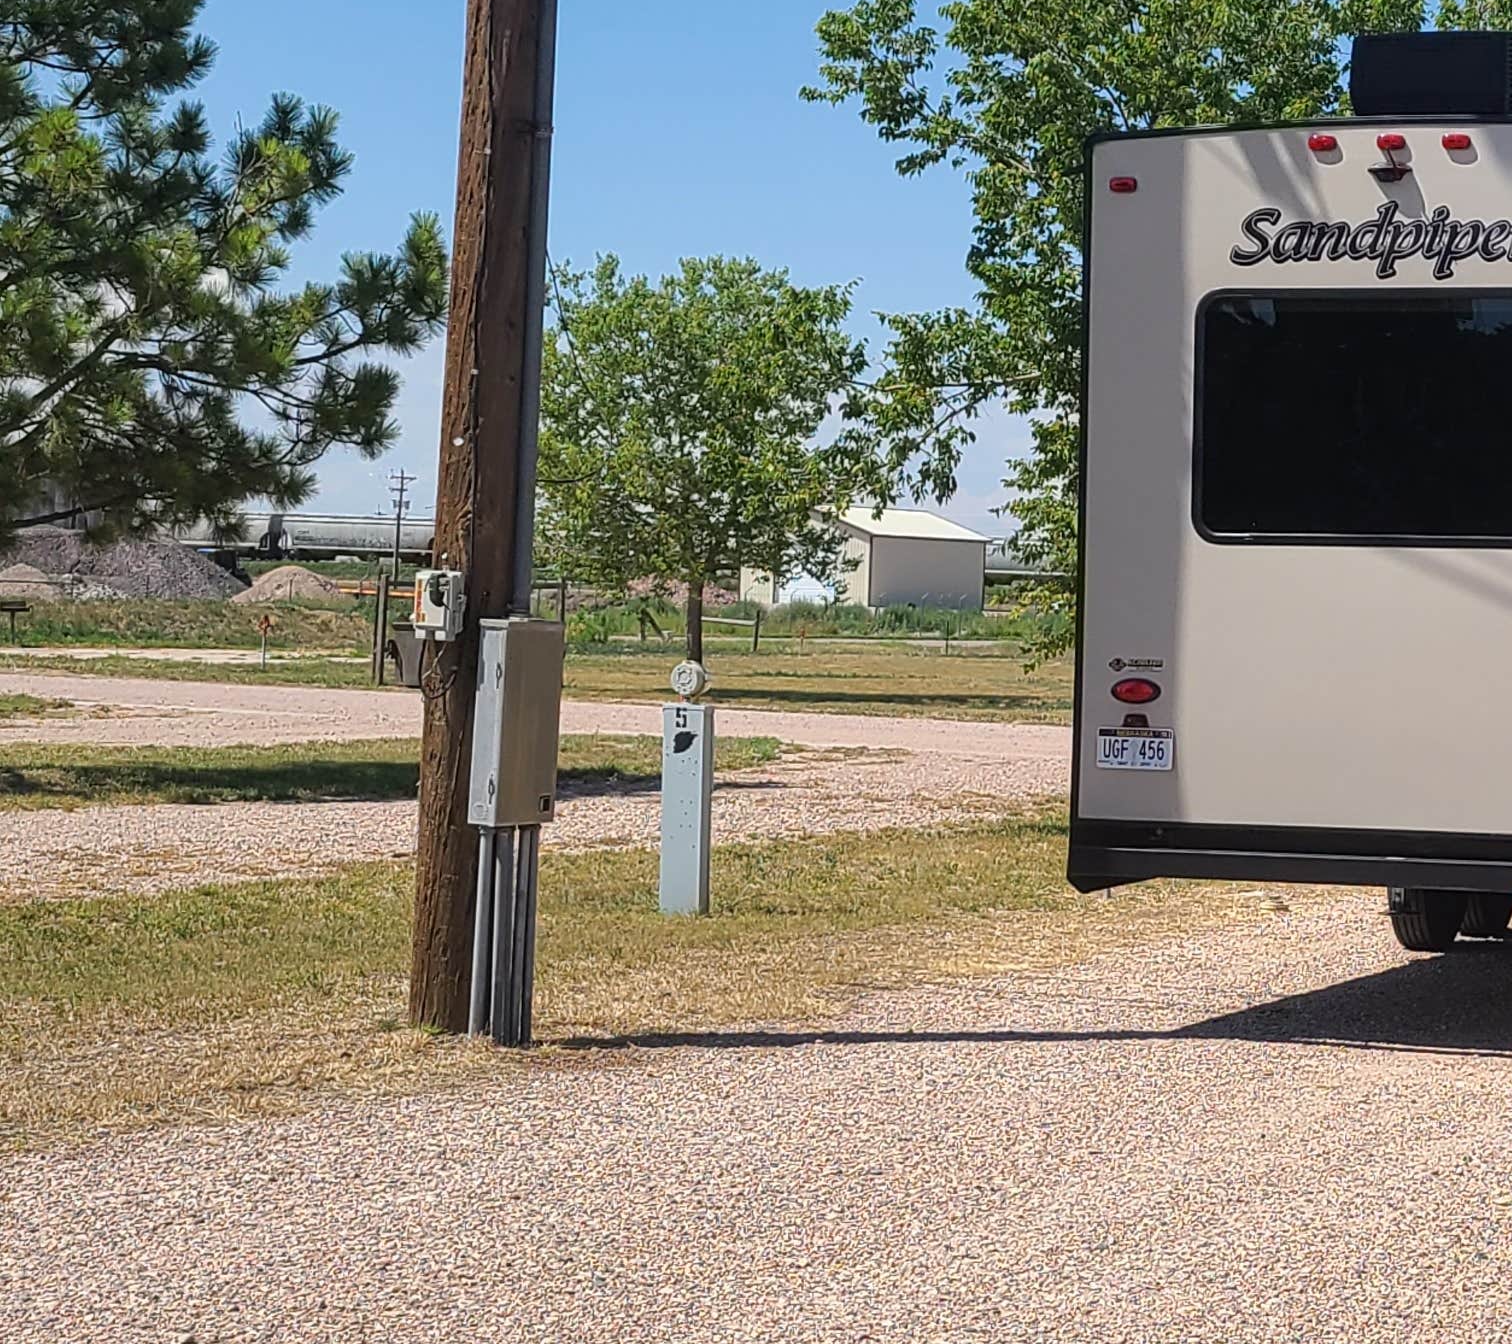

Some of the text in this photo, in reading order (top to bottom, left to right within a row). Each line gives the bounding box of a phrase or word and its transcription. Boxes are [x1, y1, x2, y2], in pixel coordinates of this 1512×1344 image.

[675, 707, 688, 728] 5
[1103, 737, 1165, 761] UGF 456
